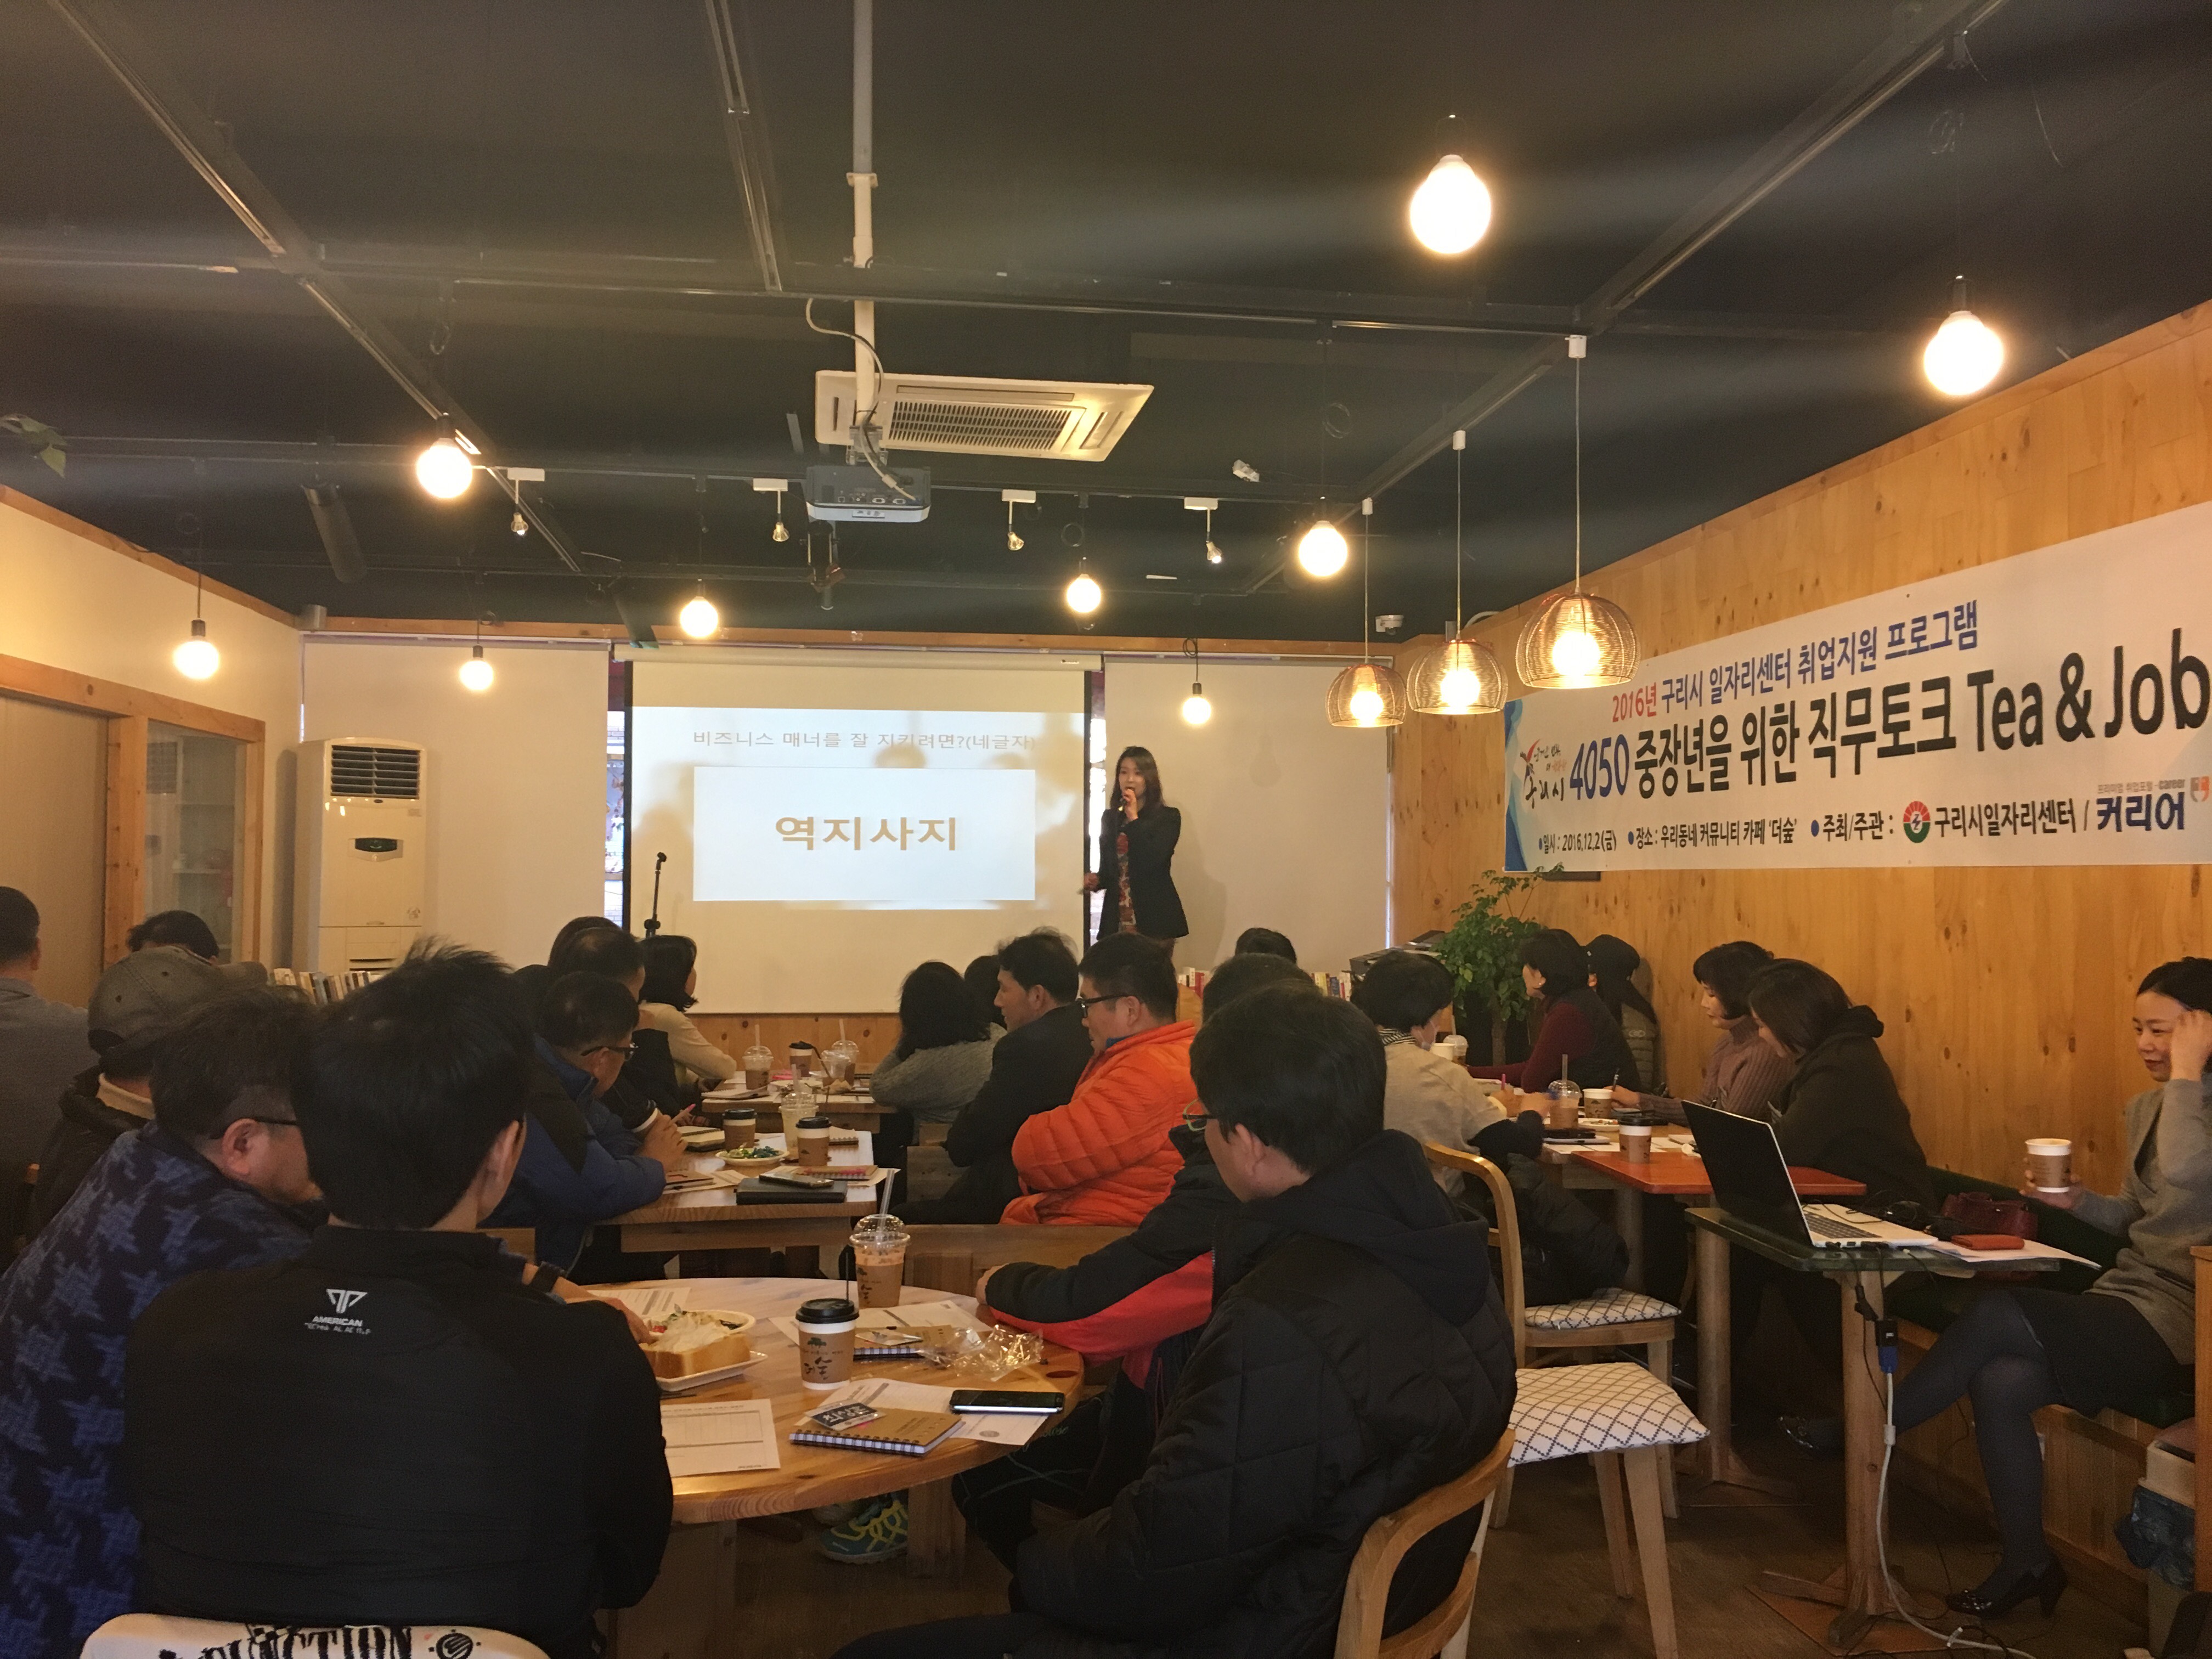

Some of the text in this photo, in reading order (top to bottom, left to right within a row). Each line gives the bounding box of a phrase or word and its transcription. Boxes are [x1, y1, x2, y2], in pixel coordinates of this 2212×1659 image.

[1612, 600, 1978, 723] 2016년 구리시 일자리센터 취업지원 프로그램
[1570, 628, 2211, 800] 4050 중장년을 위한 직무토크 Tea & Job
[693, 731, 774, 747] 비즈니스
[782, 732, 842, 748] 매너를
[850, 732, 869, 748] 잘
[1934, 798, 2077, 837] 구리시일자리센터
[2096, 792, 2185, 832] 커리어
[775, 816, 957, 851] 역지사지
[1562, 830, 1617, 852] 2016.12.2(금)
[1661, 823, 1697, 848] 우리동네
[1700, 820, 1740, 847] 커뮤니티
[1743, 819, 1765, 845] 카페
[312, 1316, 363, 1327] AMERICAN
